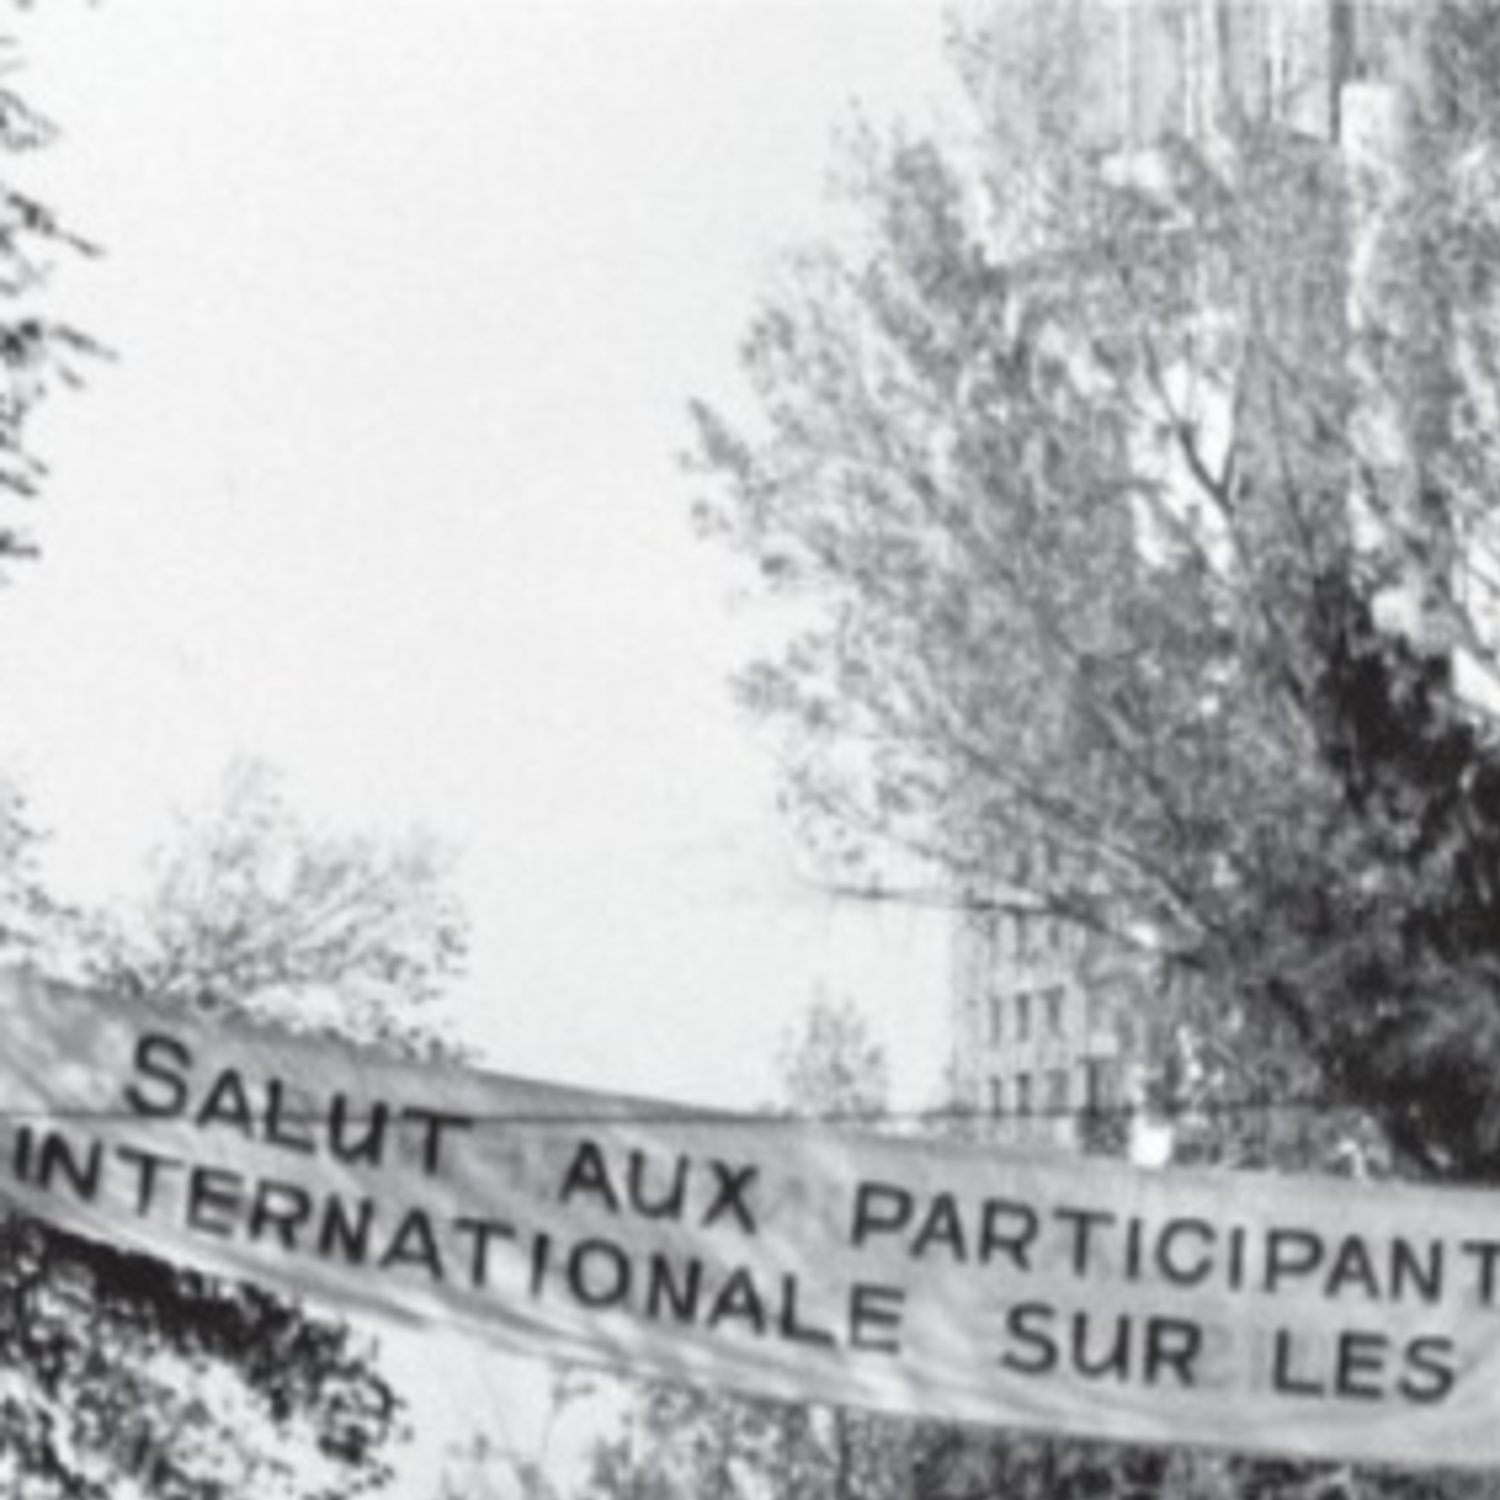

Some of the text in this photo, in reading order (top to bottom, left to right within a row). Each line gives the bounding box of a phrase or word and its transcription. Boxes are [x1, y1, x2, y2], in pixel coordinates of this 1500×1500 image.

[124, 1032, 472, 1177] SALUT
[560, 1139, 762, 1234] AUX
[11, 1124, 907, 1355] INTERNATIONALE
[1001, 1301, 1205, 1389] SUR
[1271, 1327, 1457, 1402] LES
